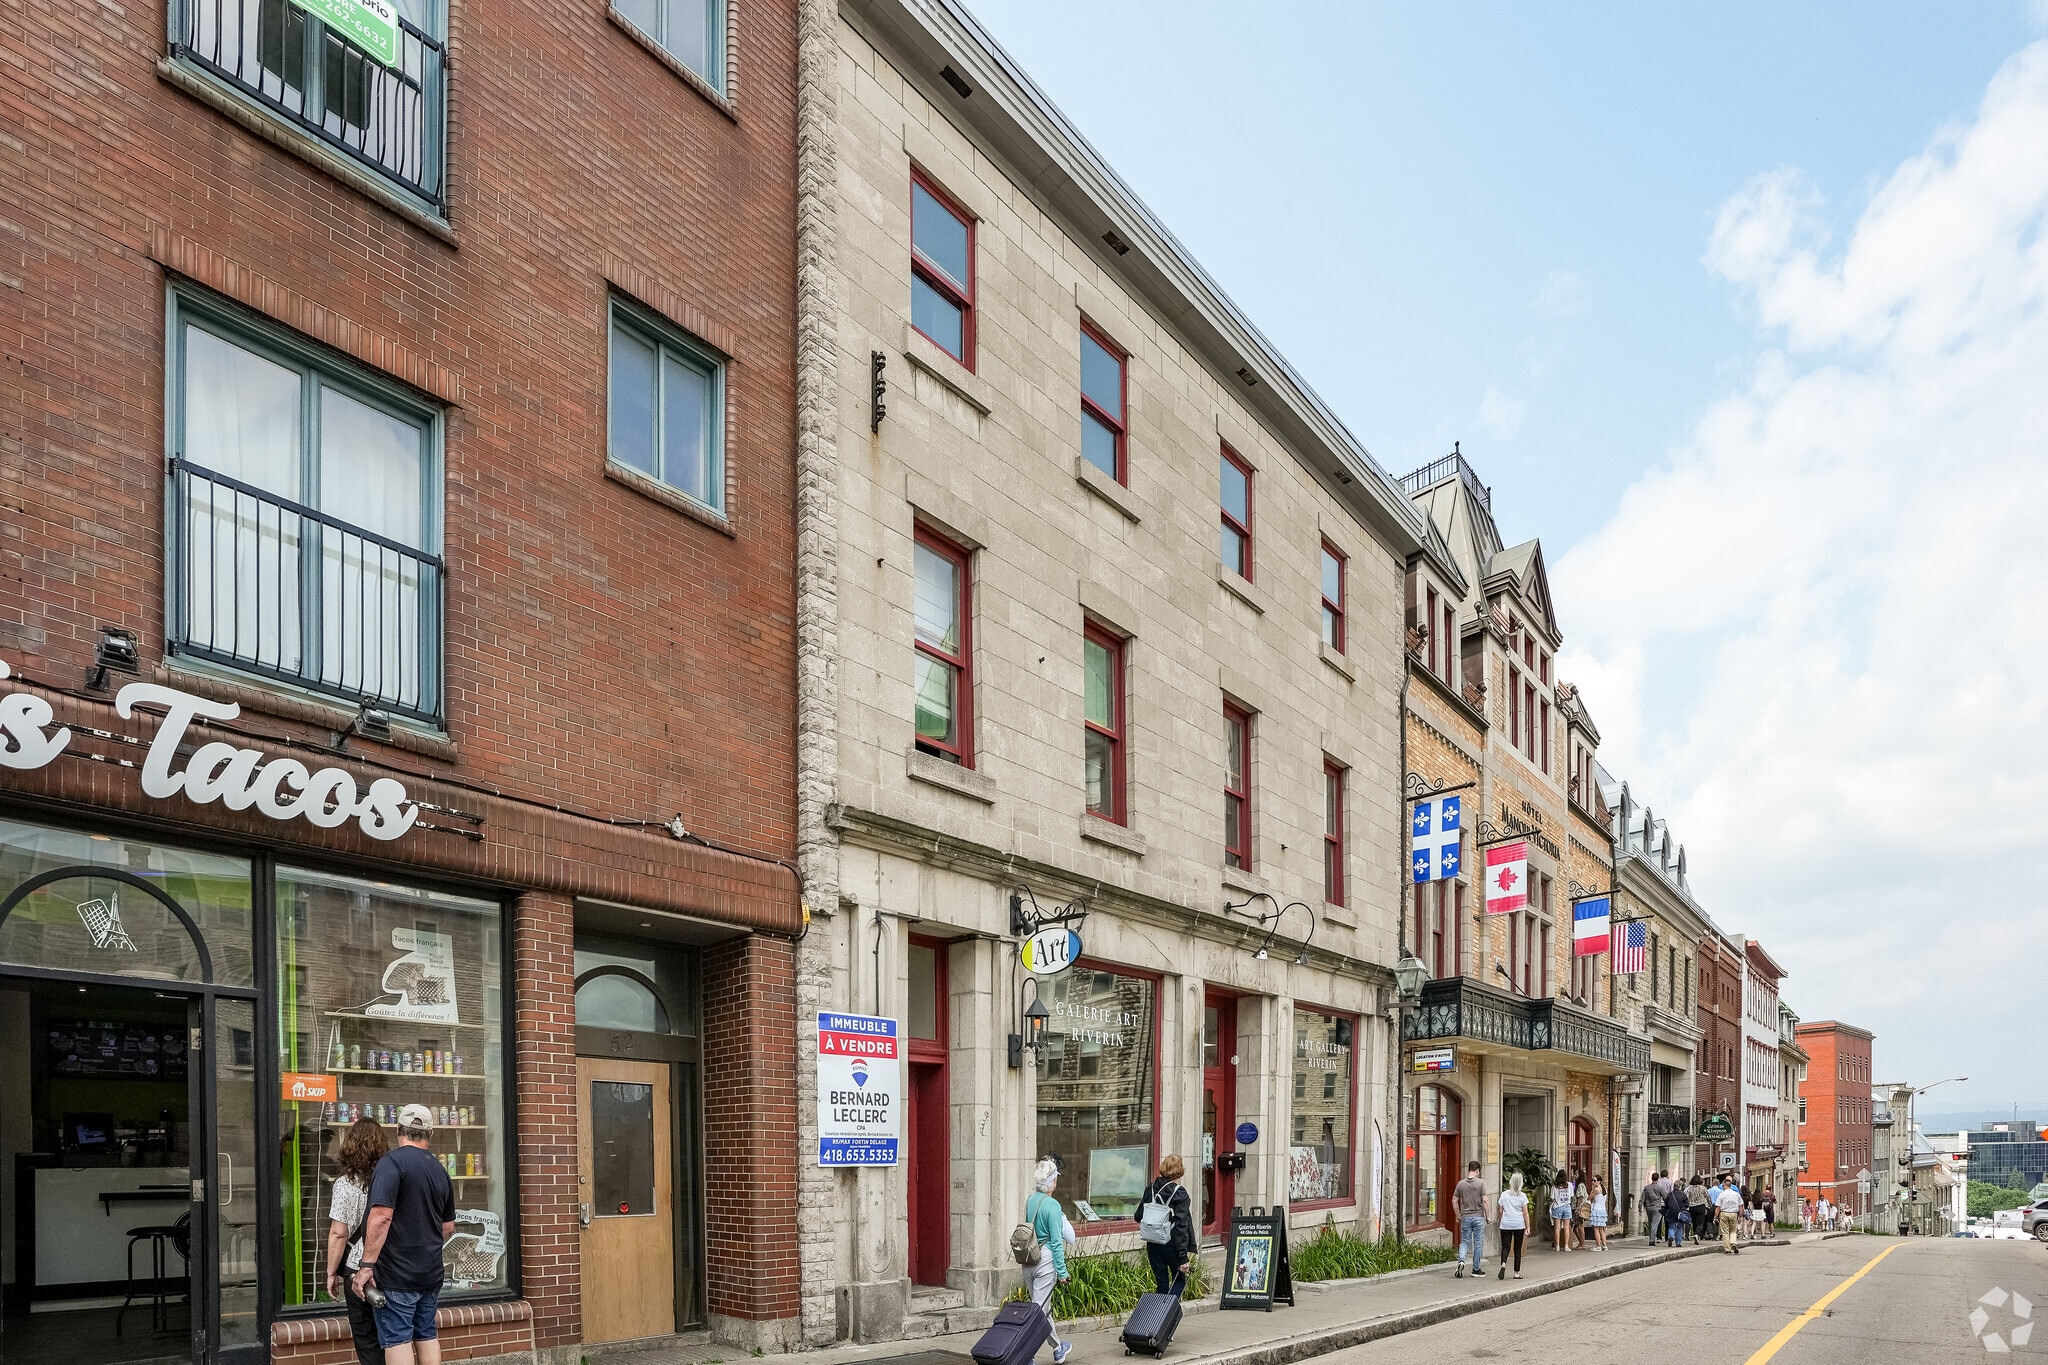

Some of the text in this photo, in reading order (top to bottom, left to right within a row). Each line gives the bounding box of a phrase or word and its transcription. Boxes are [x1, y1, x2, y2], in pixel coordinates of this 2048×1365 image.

[115, 682, 418, 841] Tacos
[393, 934, 444, 949] Tacos français
[1033, 934, 1069, 968] Art
[367, 1006, 396, 1017] Goûtez
[398, 1009, 406, 1017] la
[407, 1010, 445, 1021] différence
[1055, 1001, 1139, 1027] GALERIE ART
[830, 1017, 888, 1033] IMMEUBLE
[825, 1034, 893, 1055] À VENDRE
[1071, 1027, 1124, 1047] RIVERIN
[1299, 1039, 1346, 1055] ART GALLERY
[1308, 1057, 1337, 1070] RIVERIN
[306, 1087, 326, 1097] SKIP
[830, 1091, 890, 1107] BERNARD
[833, 1108, 887, 1123] LECLERC
[823, 1149, 894, 1162] 418.653.5353
[1725, 1157, 1732, 1165] P
[473, 1215, 500, 1226] français
